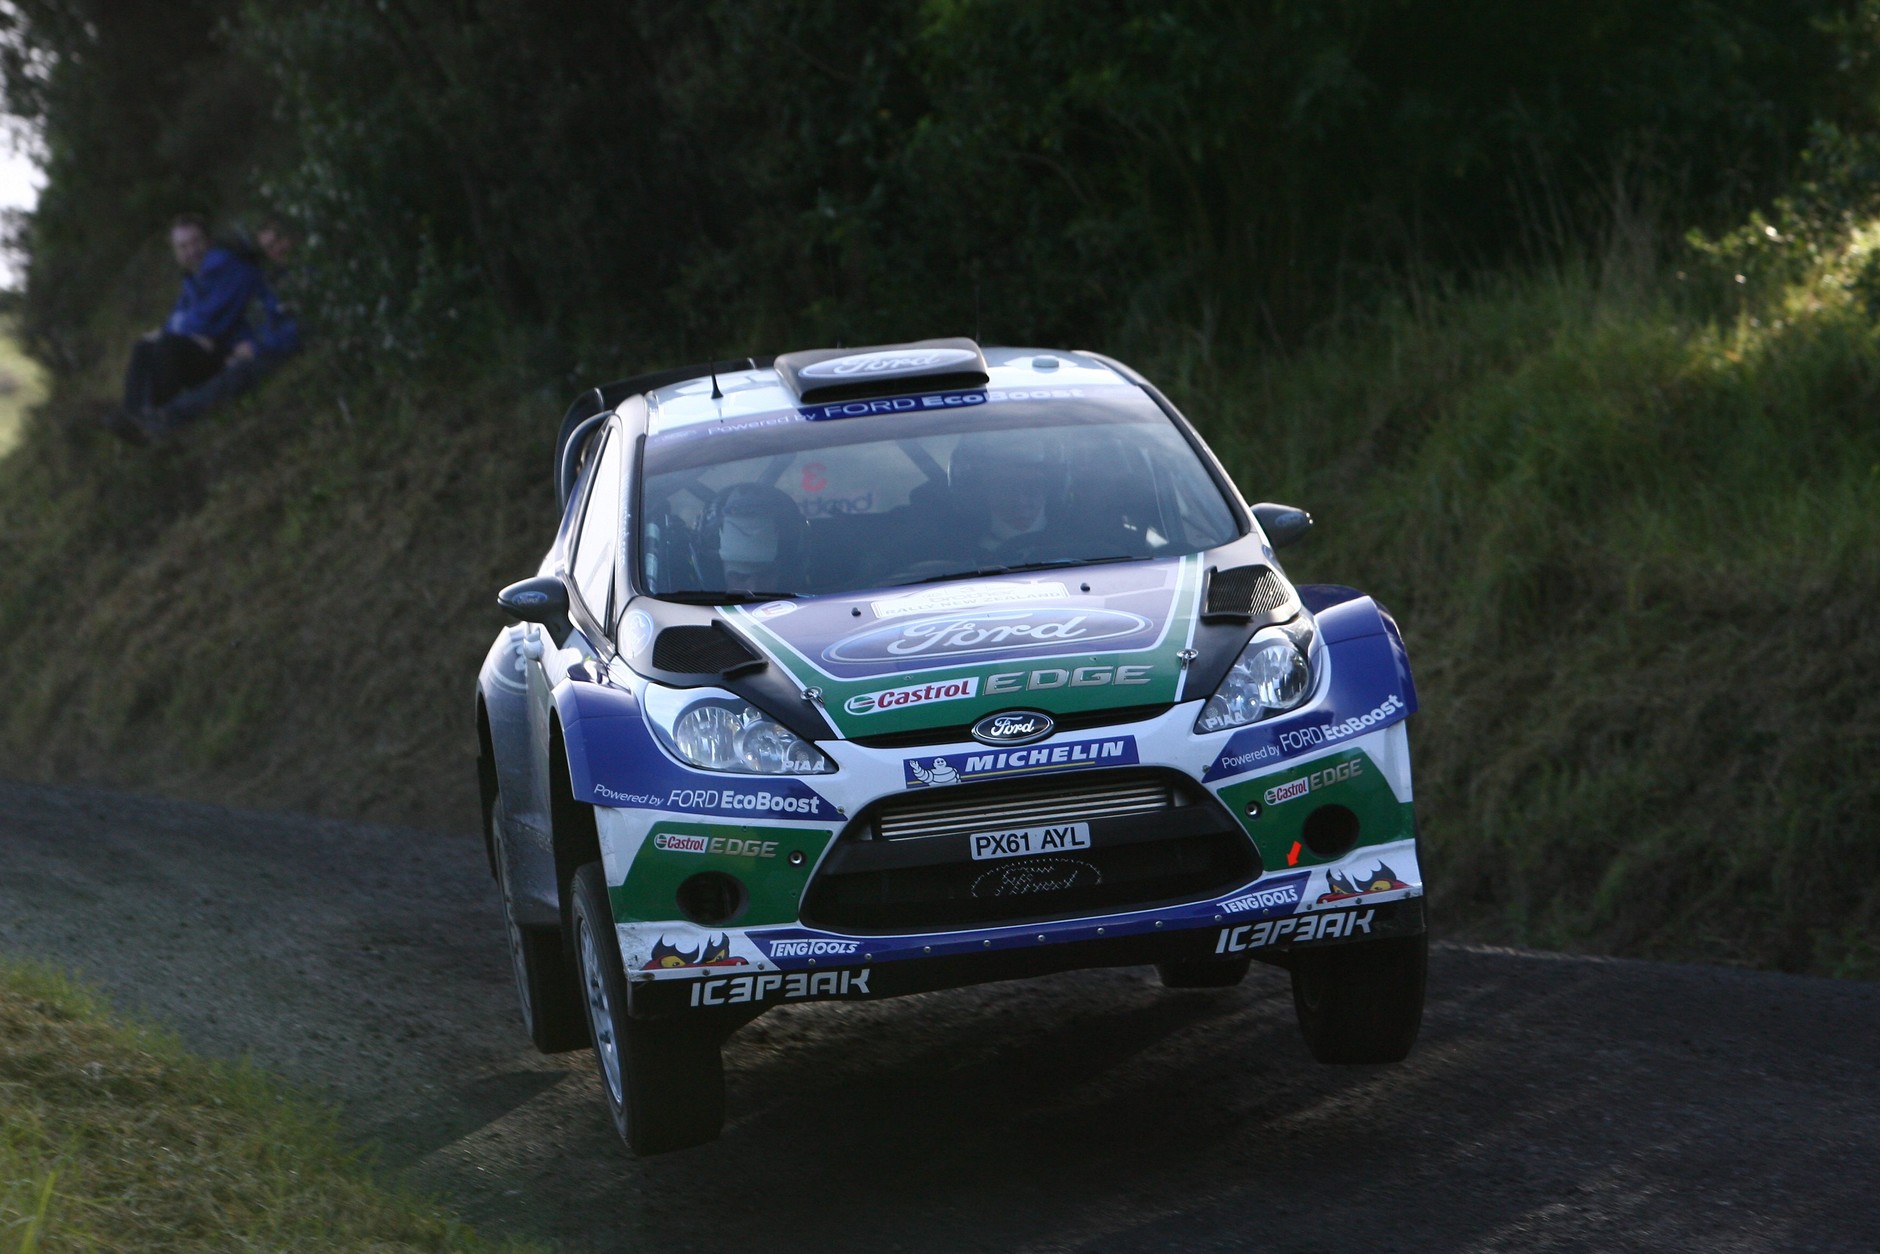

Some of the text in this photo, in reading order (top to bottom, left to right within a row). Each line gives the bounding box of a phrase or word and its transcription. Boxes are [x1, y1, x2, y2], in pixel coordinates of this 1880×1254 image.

[833, 353, 943, 374] Ford
[708, 387, 1084, 435] Powered by FORD EcoBoost
[885, 603, 934, 614] RALLY
[941, 597, 977, 608] NEW
[983, 592, 1060, 602] ZEALAND
[887, 612, 1088, 655] Ford
[877, 665, 1154, 709] Castrol EDGE
[990, 716, 1035, 737] Ford
[1206, 711, 1245, 729] PIAA
[1221, 694, 1404, 769] Powered by FORD EcoBoost
[781, 760, 825, 771] PIAA
[965, 741, 1124, 772] MICHELIN
[1276, 759, 1364, 801] Castrol EDGE
[594, 784, 819, 814] Powered by FORD EcoBoost
[667, 836, 780, 859] Castrol EDGE
[976, 826, 1085, 857] PX61 AYL
